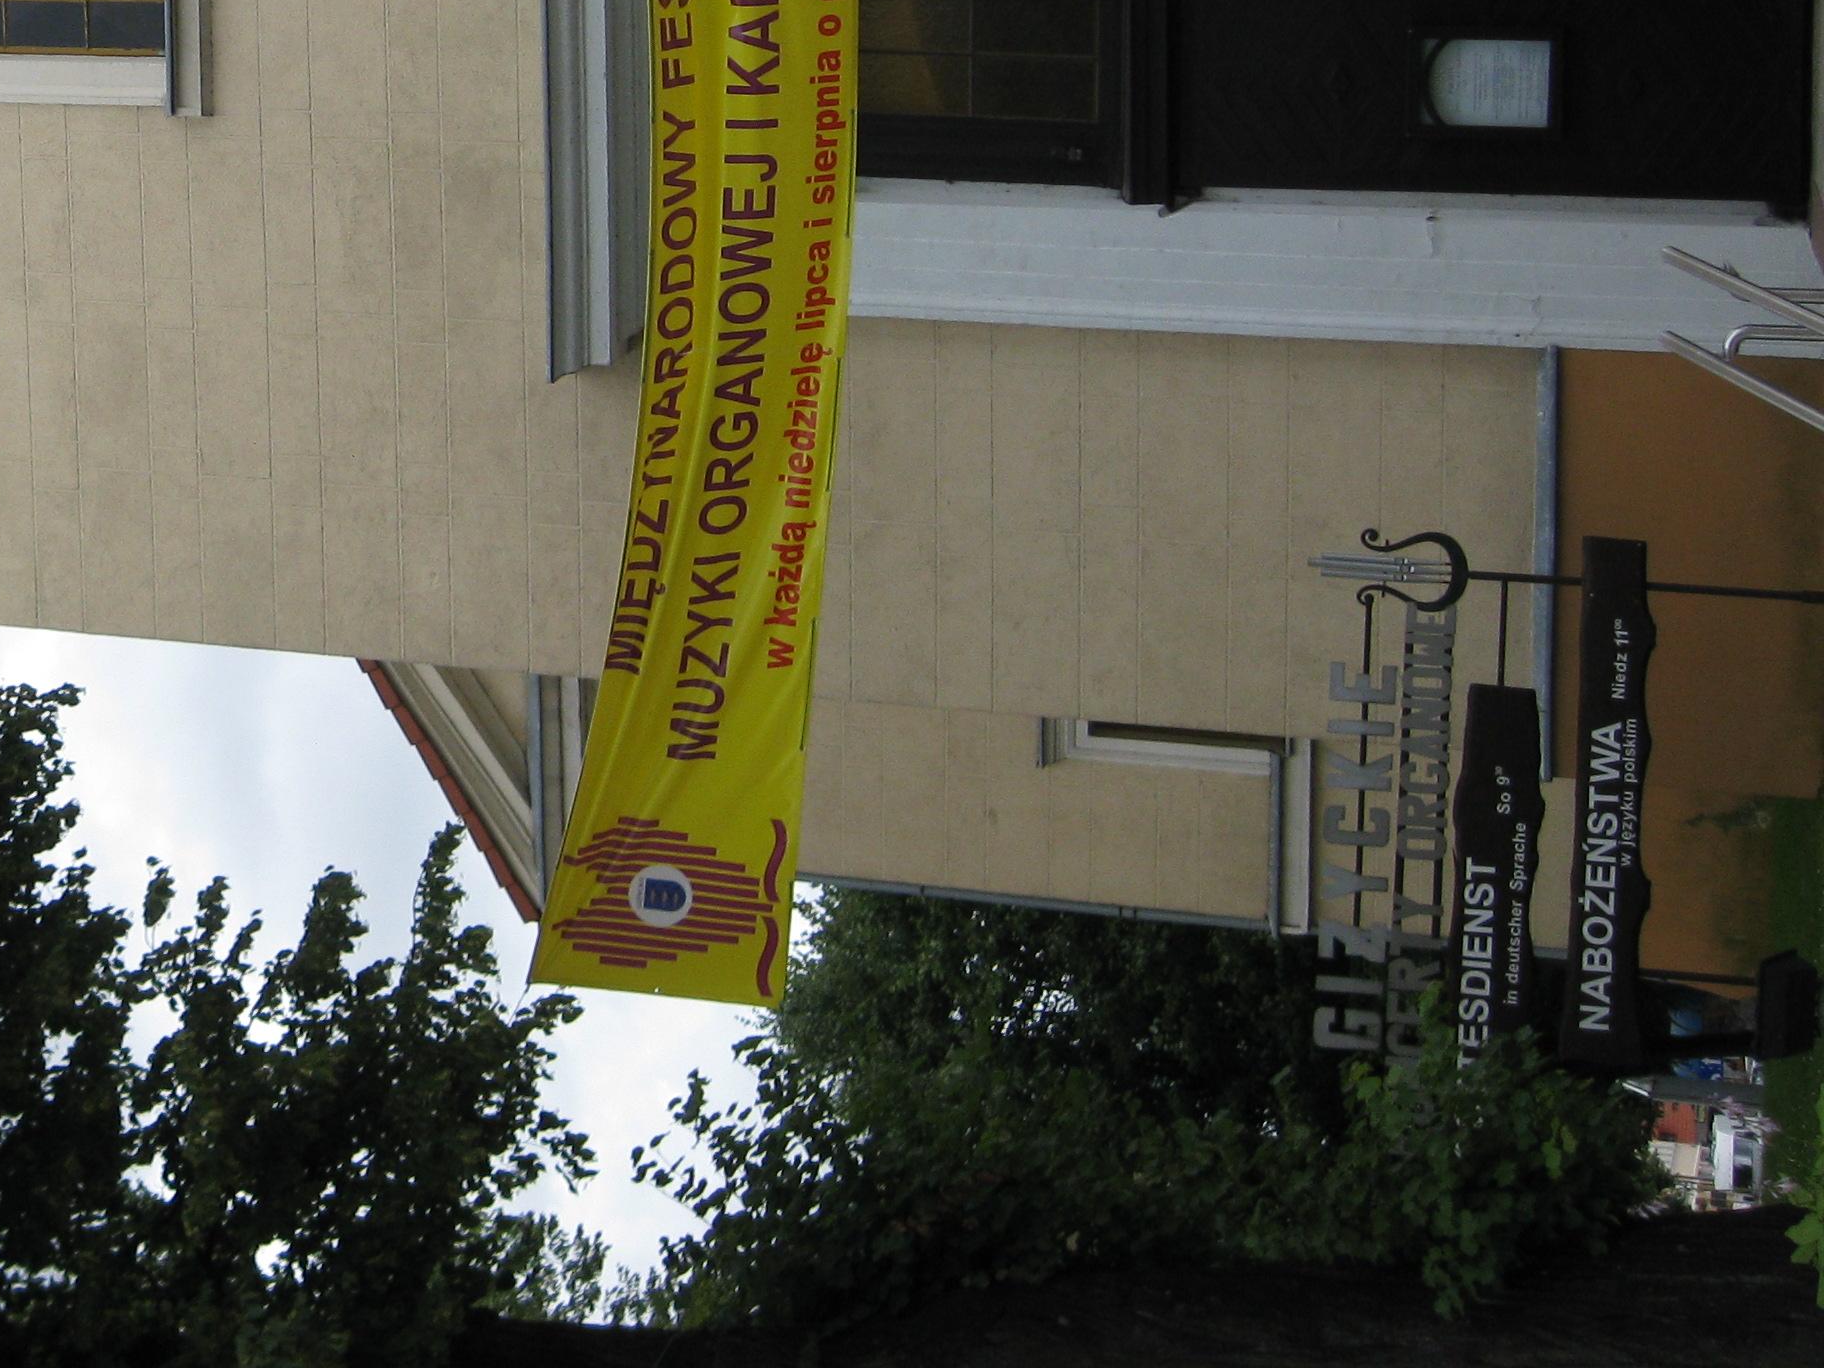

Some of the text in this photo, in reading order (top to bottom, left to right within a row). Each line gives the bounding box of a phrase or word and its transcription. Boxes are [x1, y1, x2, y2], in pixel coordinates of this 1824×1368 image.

[817, 15, 841, 36] o
[726, 119, 777, 129] I
[806, 51, 844, 203] sierpnia
[795, 240, 834, 329] lipca
[805, 219, 832, 227] i
[603, 110, 697, 675] MIĘDZYNARODOWY
[697, 153, 778, 535] ORGANOWEJ
[783, 343, 830, 508] niedzielę
[764, 521, 816, 626] każdą
[666, 551, 742, 760] MUZYKI
[768, 640, 794, 669] w
[1394, 603, 1457, 861] ORGANOWE
[1497, 793, 1511, 814] So
[1619, 718, 1641, 866] w języku polskim
[1503, 823, 1529, 1005] in deutscher Sprache
[1577, 722, 1622, 1031] NABOŻEŃSTWA
[1611, 653, 1628, 699] Niedz
